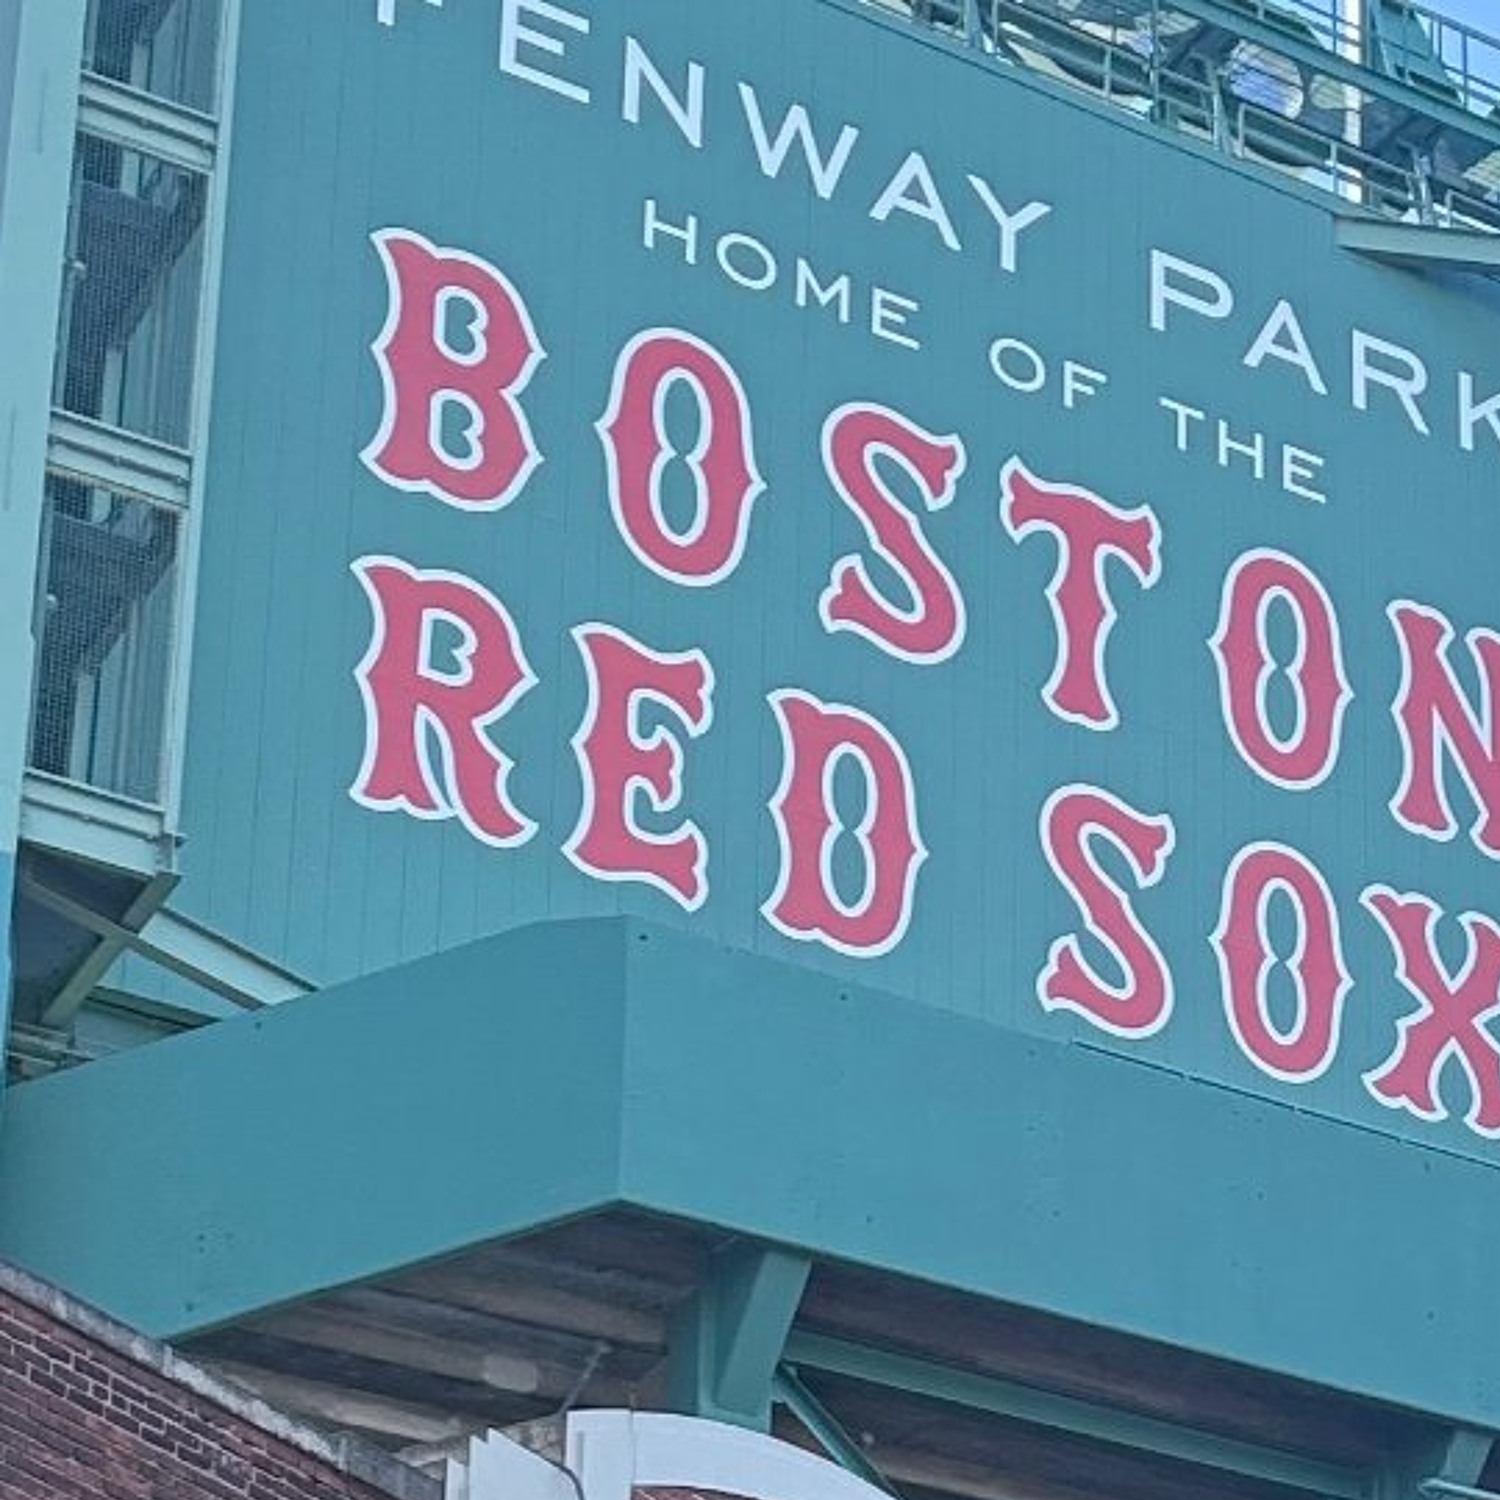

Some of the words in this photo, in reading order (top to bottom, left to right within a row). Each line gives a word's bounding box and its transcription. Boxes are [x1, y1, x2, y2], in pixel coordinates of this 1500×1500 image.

[377, 0, 1051, 272] ENWAY
[643, 200, 921, 350] HOME
[988, 338, 1107, 408] OF
[1160, 397, 1327, 504] THE
[349, 554, 929, 958] RED
